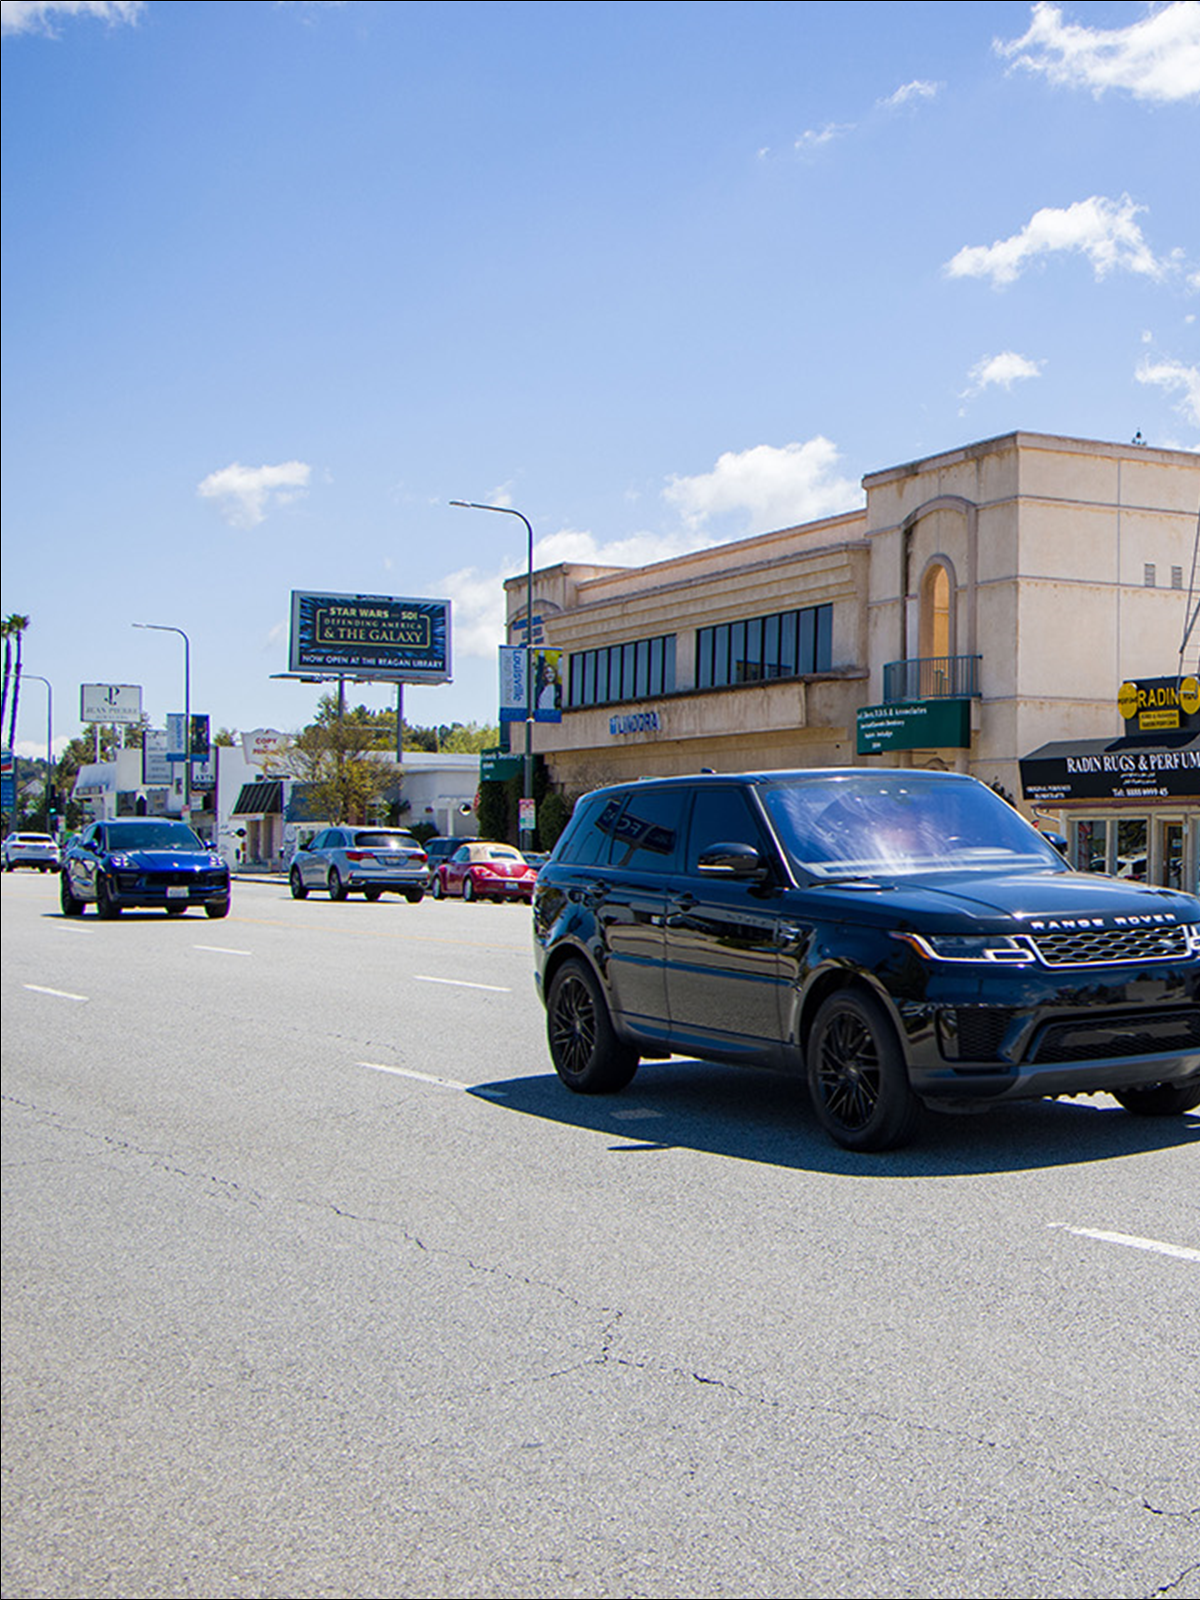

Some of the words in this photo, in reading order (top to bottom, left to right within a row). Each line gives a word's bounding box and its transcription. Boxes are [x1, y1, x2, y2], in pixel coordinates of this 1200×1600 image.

[329, 607, 357, 616] STAR
[359, 609, 389, 618] WARS
[324, 618, 378, 628] DEFENDING
[381, 621, 422, 629] AMERICA
[324, 627, 334, 639] &
[337, 628, 366, 640] THE
[369, 628, 423, 643] GALAXY
[302, 655, 324, 664] NOW
[325, 655, 348, 664] OPEN
[350, 656, 360, 664] AT
[362, 657, 376, 665] THE
[378, 657, 411, 667] REAGAN
[412, 659, 443, 668] LIBRARY
[513, 650, 525, 701] Louisville
[1138, 687, 1180, 708] RADIN
[1066, 756, 1102, 773] RADIN
[1103, 754, 1136, 772] RUGS
[1138, 754, 1148, 771] &
[1030, 918, 1105, 931] RANGE
[1114, 913, 1176, 926] ROVER
